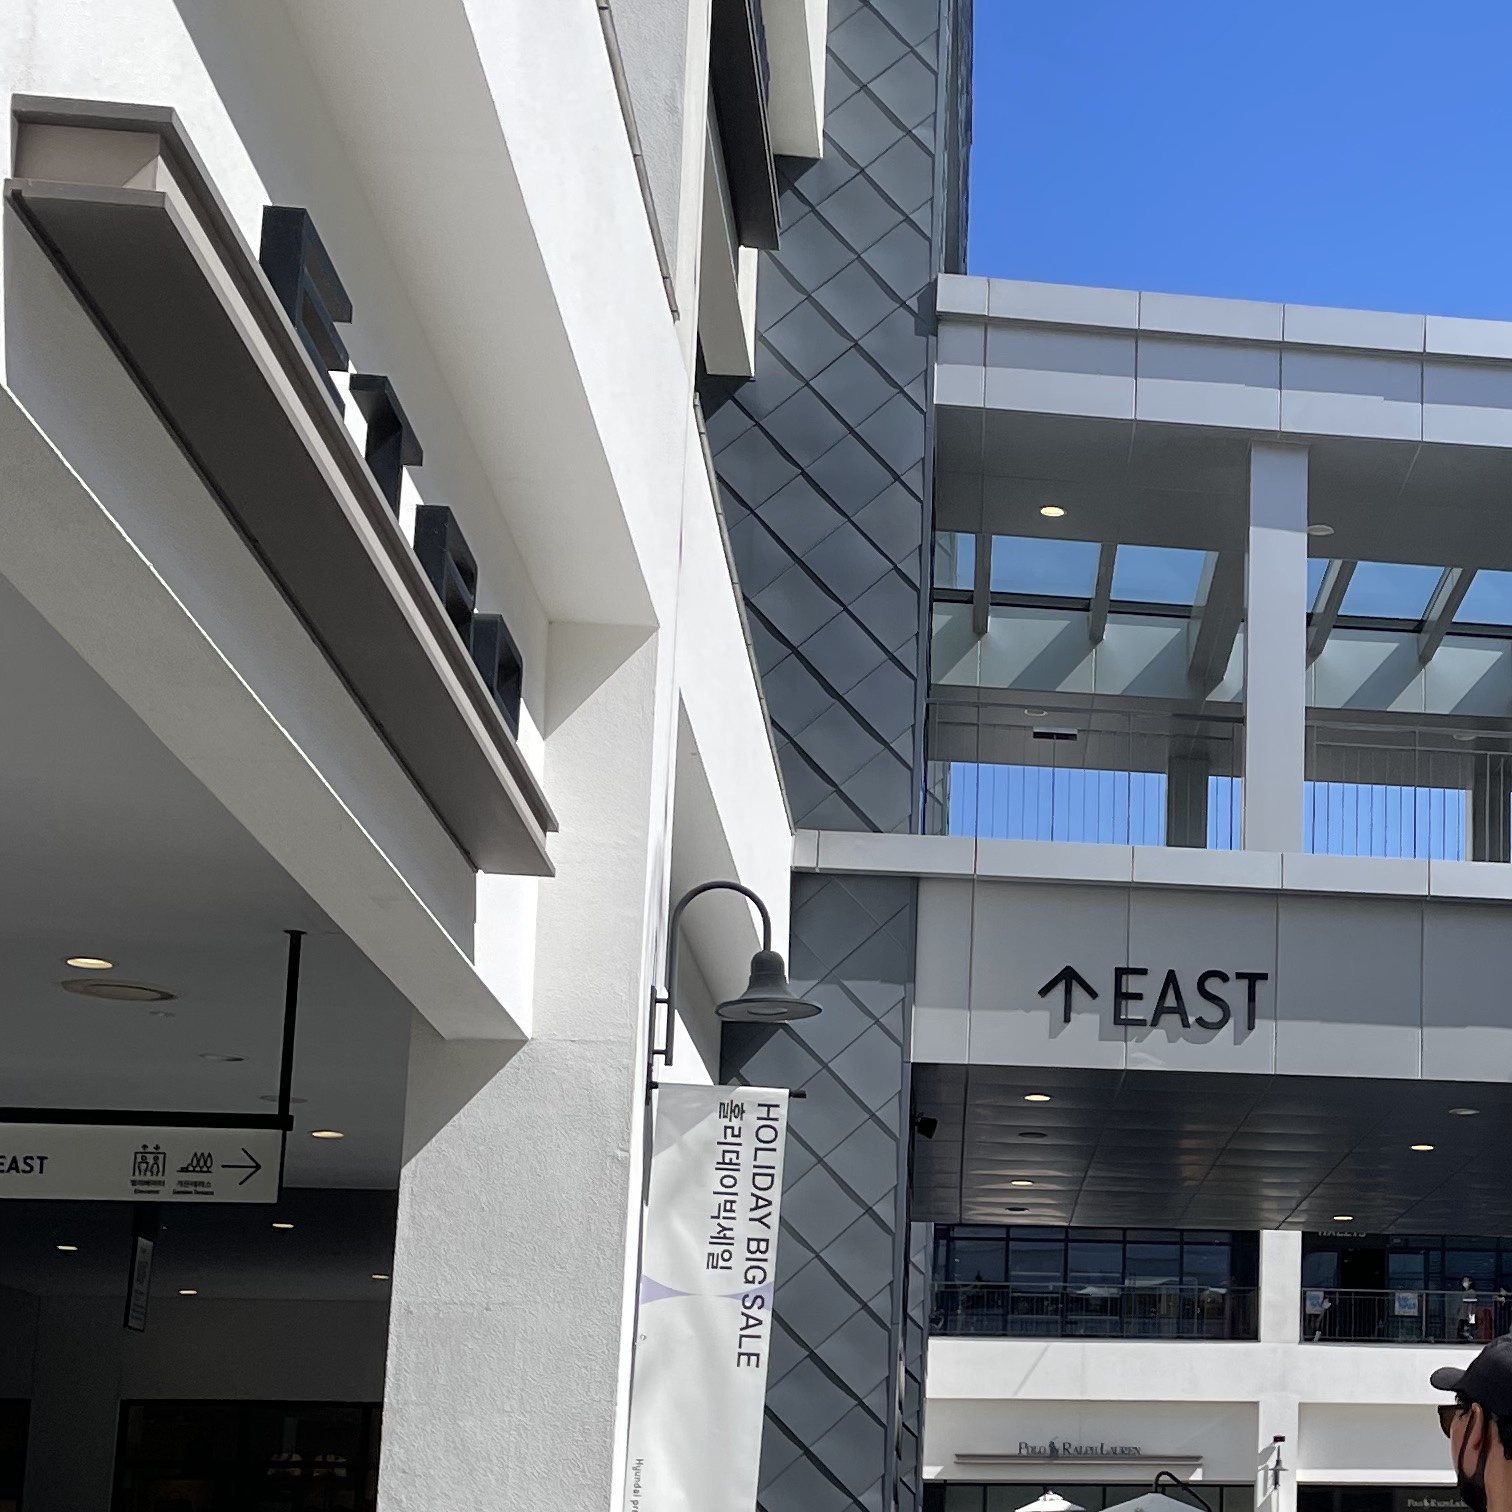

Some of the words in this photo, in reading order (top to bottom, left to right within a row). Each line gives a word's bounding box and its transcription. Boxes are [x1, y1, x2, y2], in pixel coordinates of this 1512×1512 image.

[1113, 966, 1269, 1031] EAST
[749, 1102, 781, 1230] HOLIDAY
[743, 1237, 770, 1286] BIG
[736, 1293, 765, 1369] SALE
